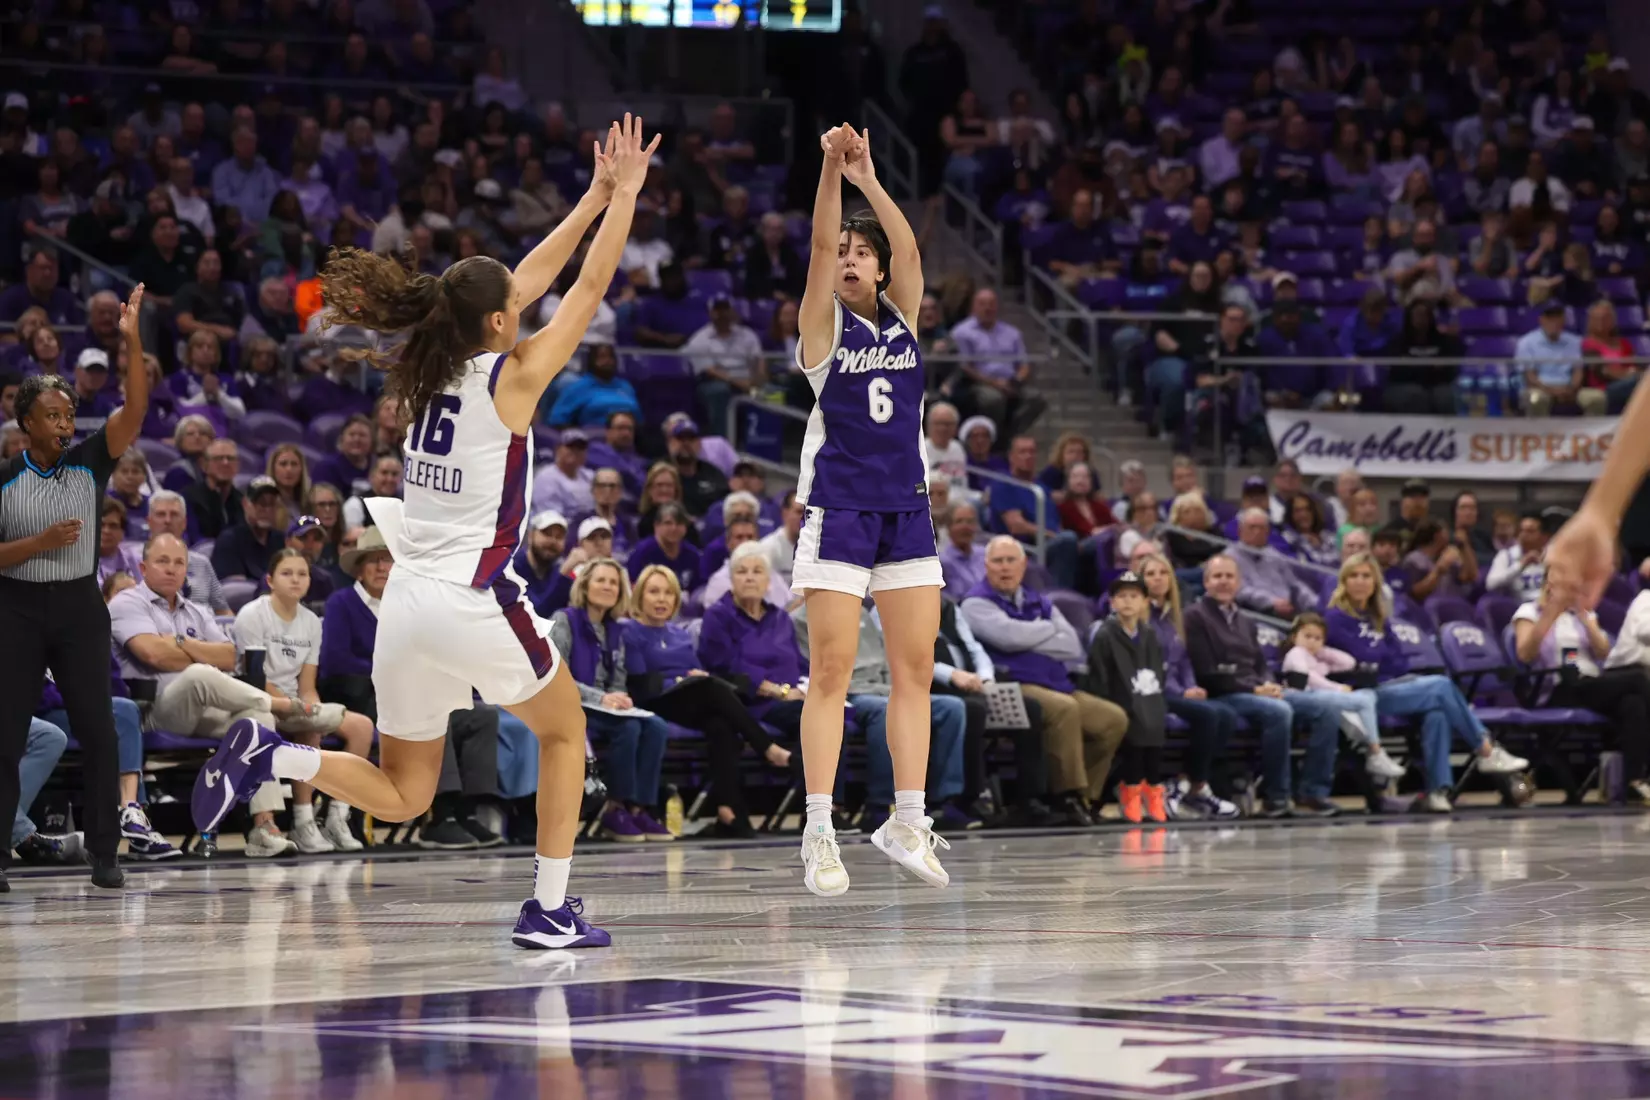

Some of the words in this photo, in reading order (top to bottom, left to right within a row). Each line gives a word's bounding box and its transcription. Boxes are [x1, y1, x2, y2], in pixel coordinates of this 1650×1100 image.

[836, 343, 918, 374] Wildcats
[410, 390, 462, 457] 16
[868, 377, 894, 424] 6
[1279, 420, 1457, 467] Campbell's
